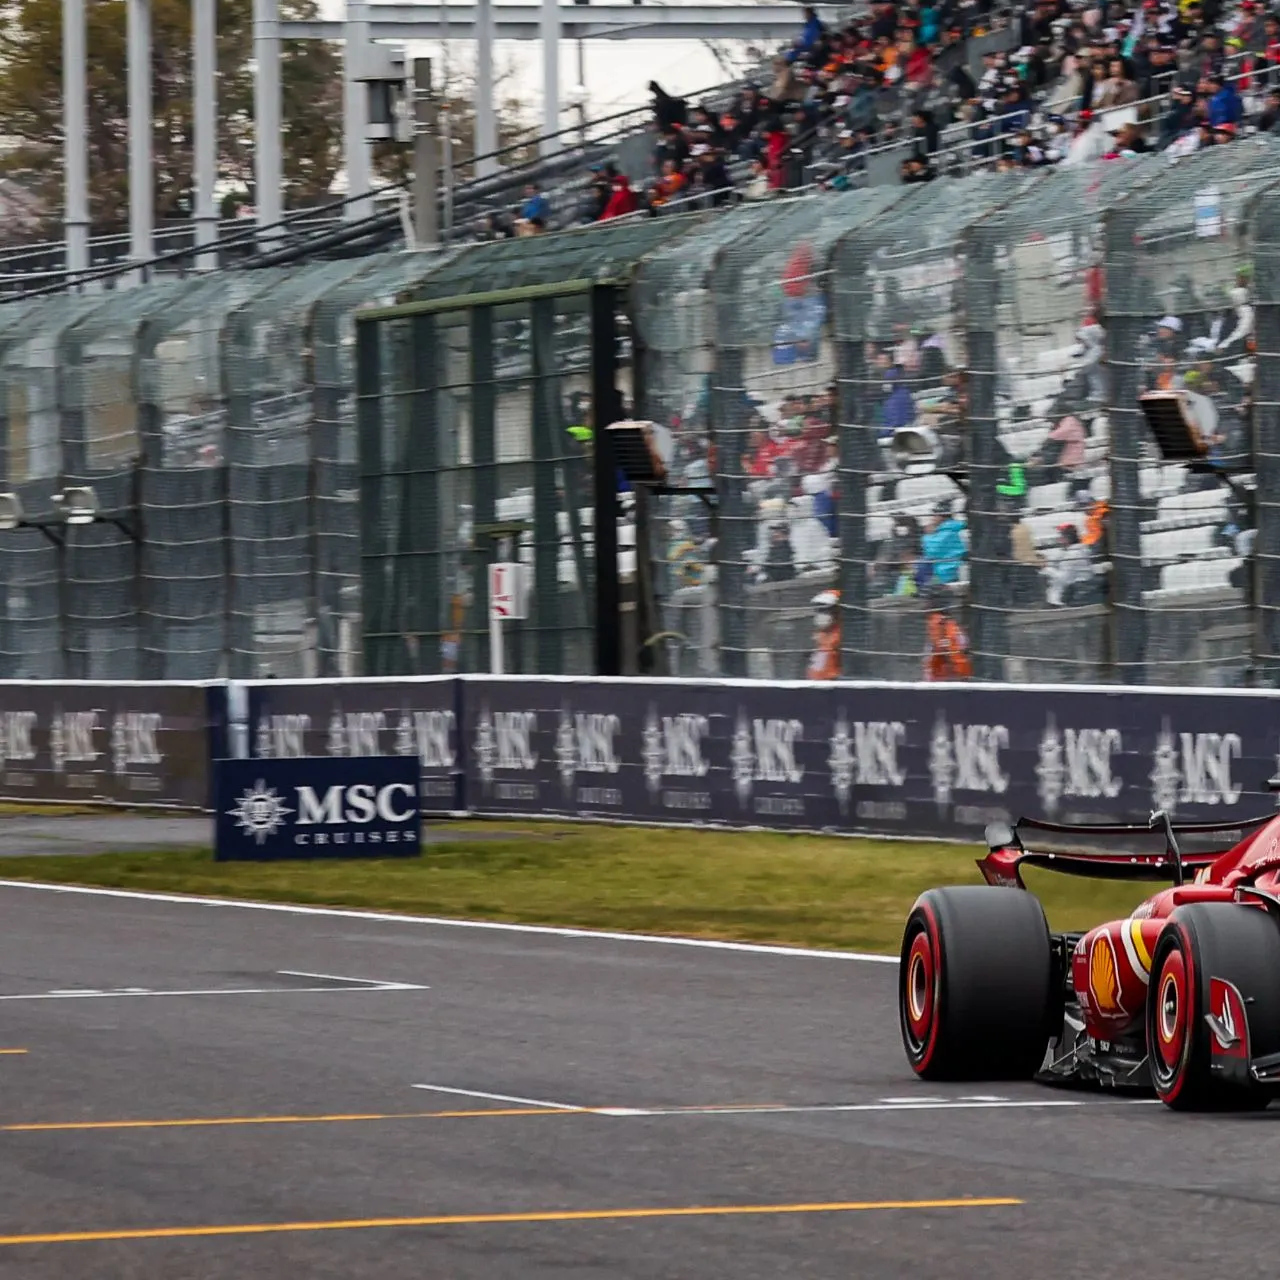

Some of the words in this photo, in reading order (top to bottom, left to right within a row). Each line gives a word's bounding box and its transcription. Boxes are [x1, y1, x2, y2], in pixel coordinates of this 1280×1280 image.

[1179, 732, 1243, 805] MSC
[294, 783, 417, 825] MSC
[294, 830, 417, 845] CRUISES
